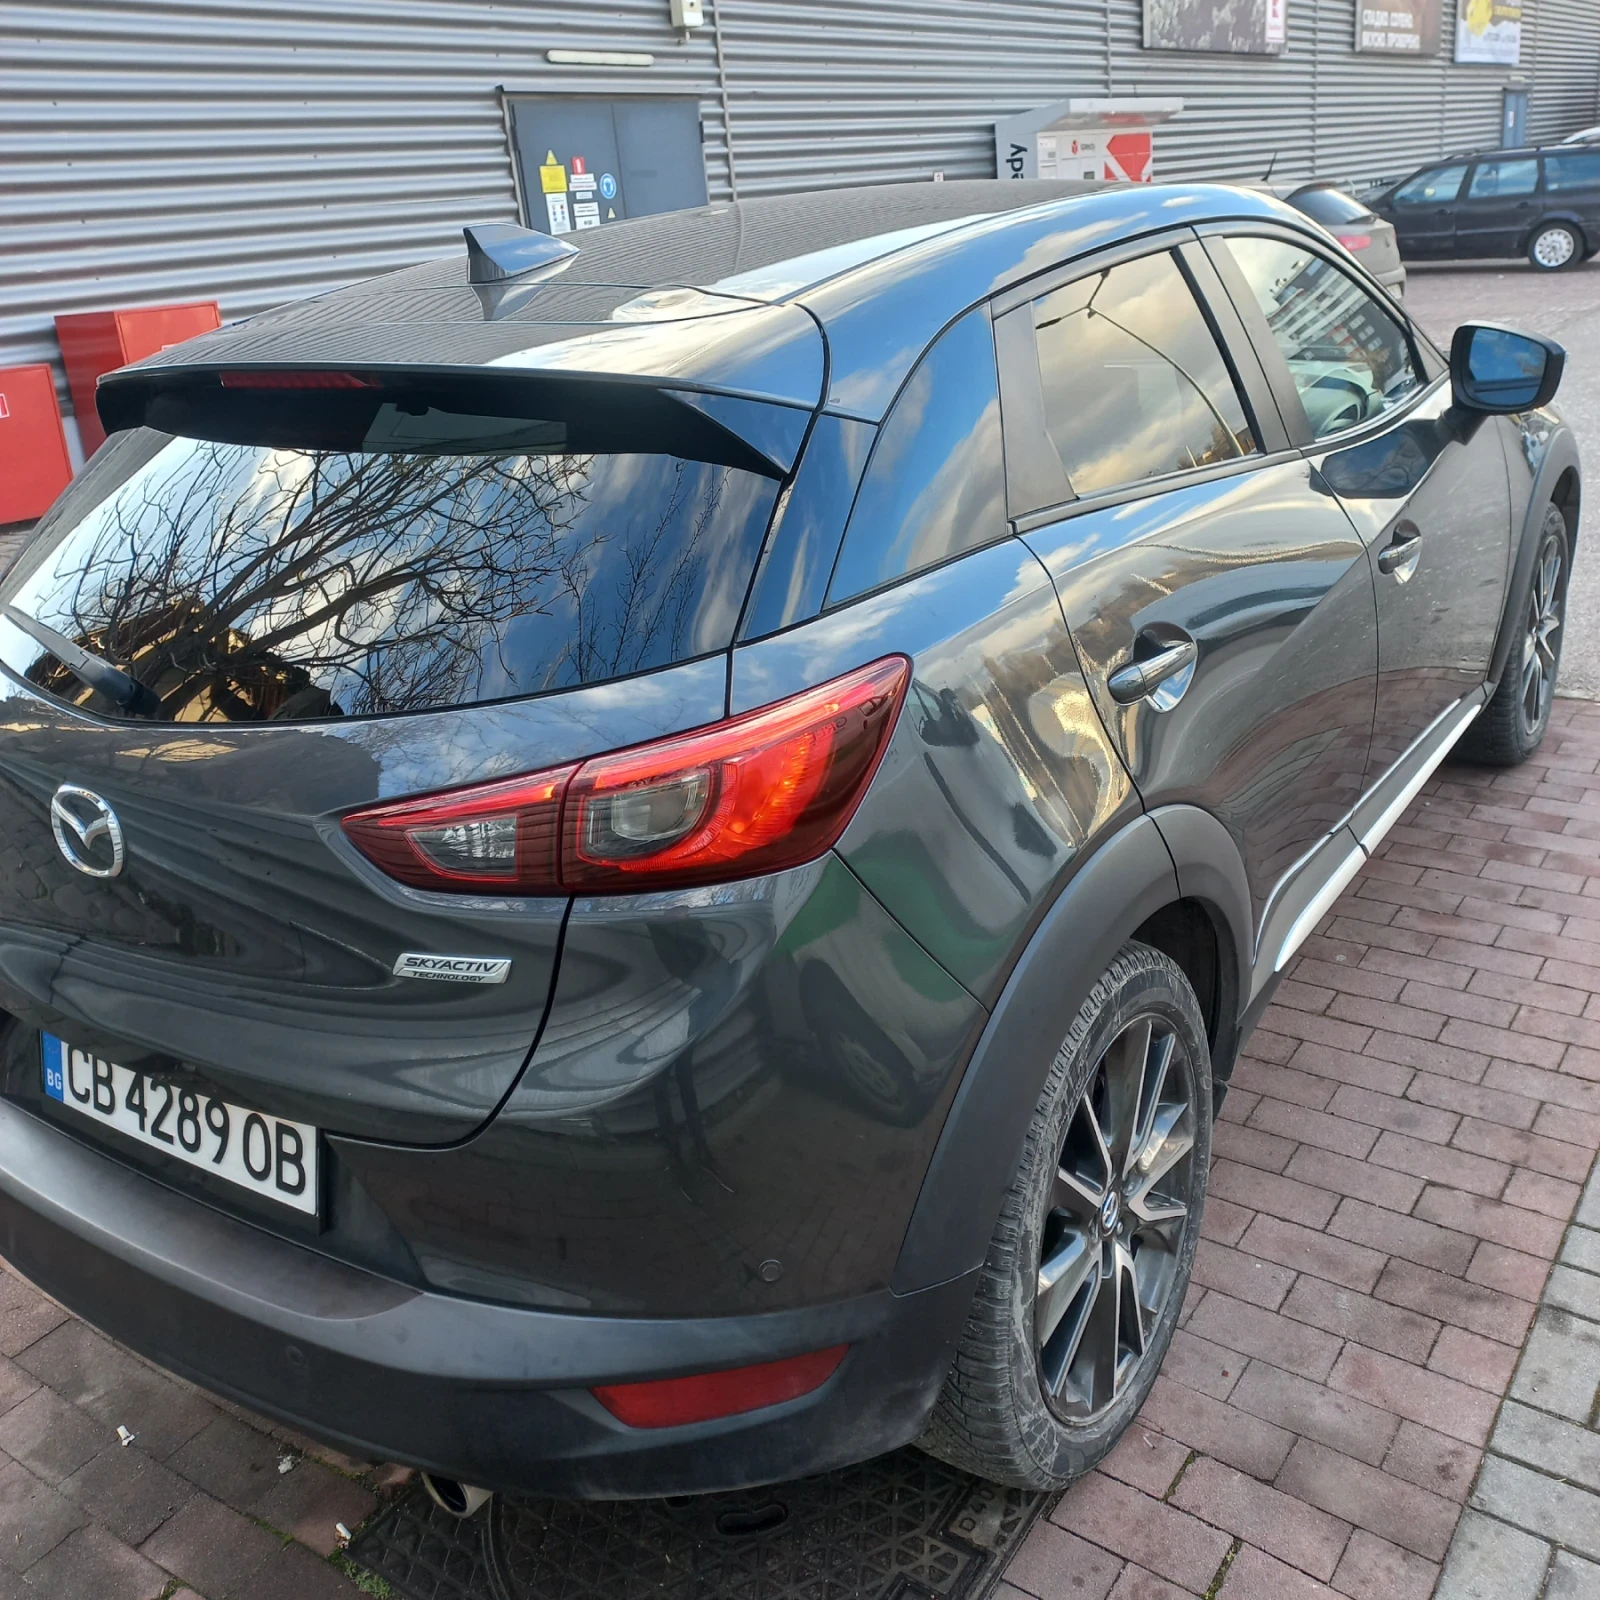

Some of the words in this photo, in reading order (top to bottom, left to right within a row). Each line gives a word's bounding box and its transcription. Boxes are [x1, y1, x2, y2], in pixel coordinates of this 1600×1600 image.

[403, 957, 498, 972] SKYACTIV
[411, 970, 486, 982] TECHNOLOGY
[46, 1068, 63, 1091] BG
[67, 1048, 116, 1116] CB
[125, 1073, 230, 1165] 4289
[242, 1112, 306, 1197] OB
[958, 1484, 1002, 1534] D40
